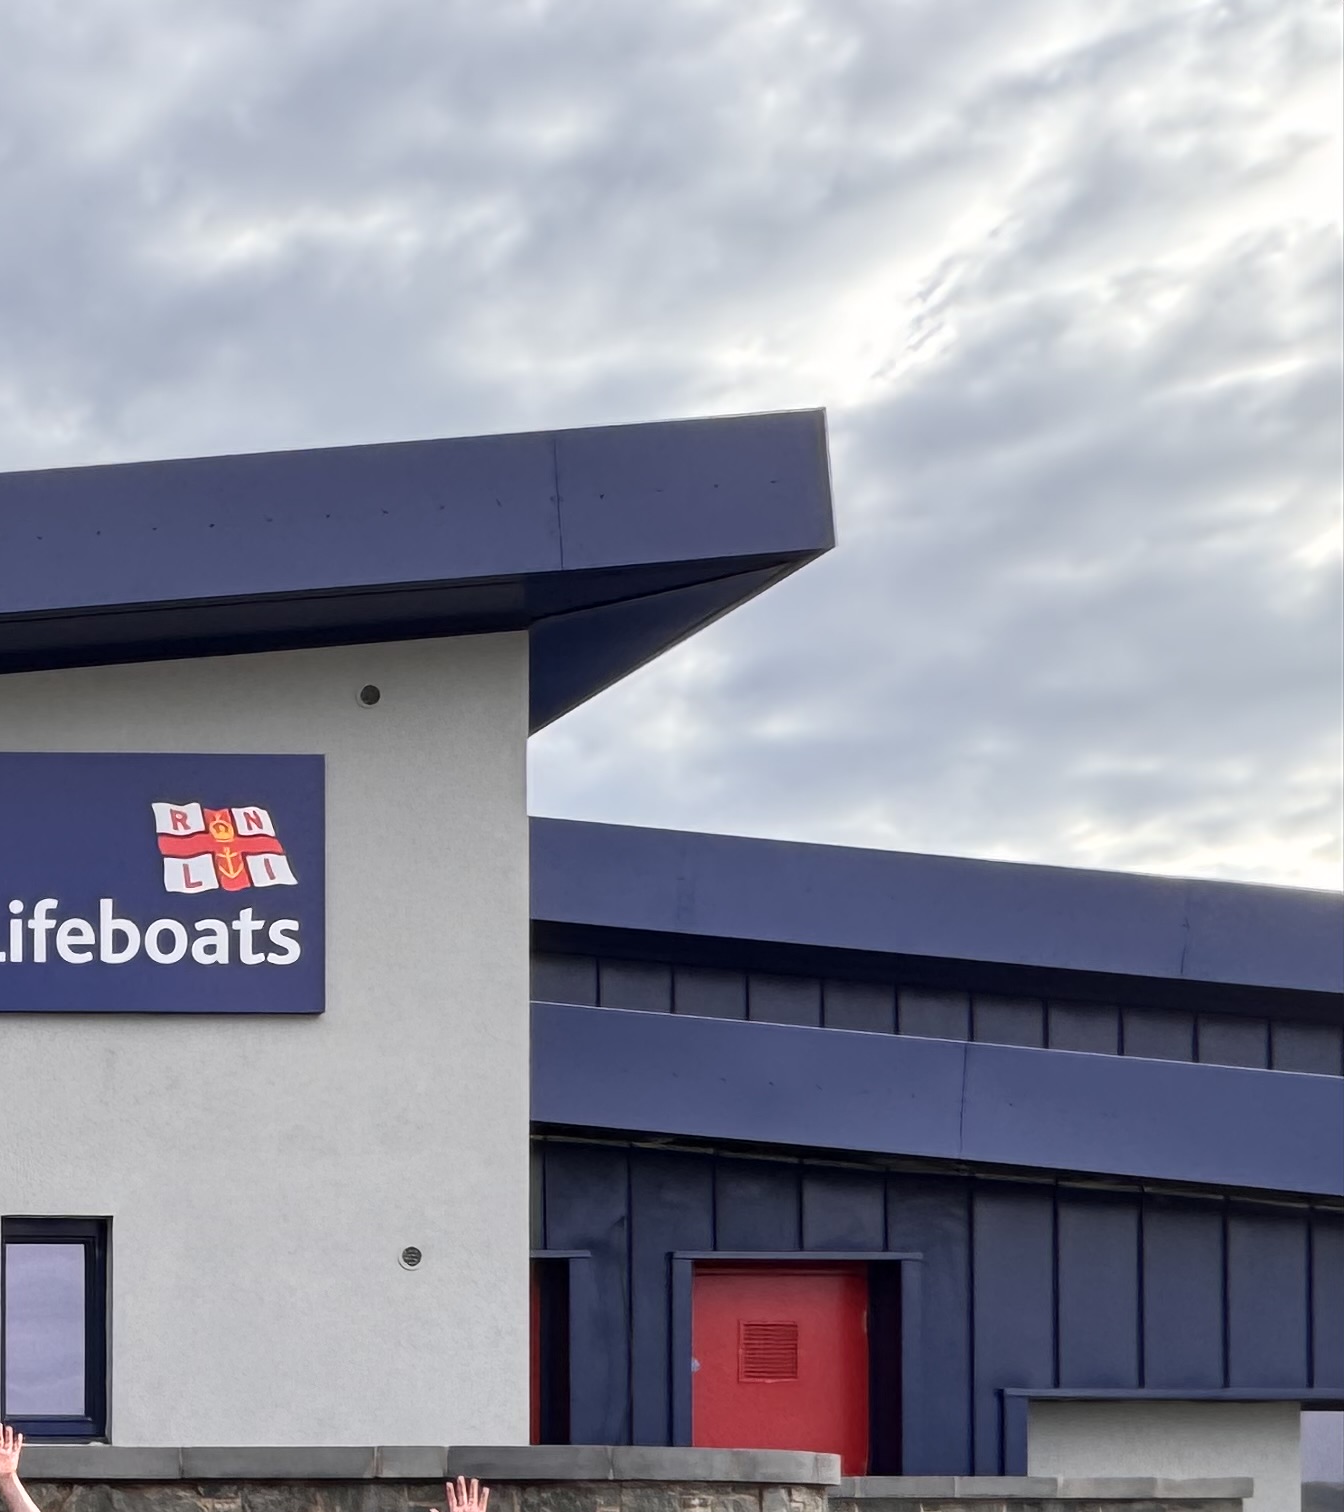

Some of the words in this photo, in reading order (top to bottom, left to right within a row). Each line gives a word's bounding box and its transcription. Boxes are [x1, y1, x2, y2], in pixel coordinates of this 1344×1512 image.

[169, 808, 191, 831] R
[243, 809, 264, 831] N
[182, 863, 203, 889] L
